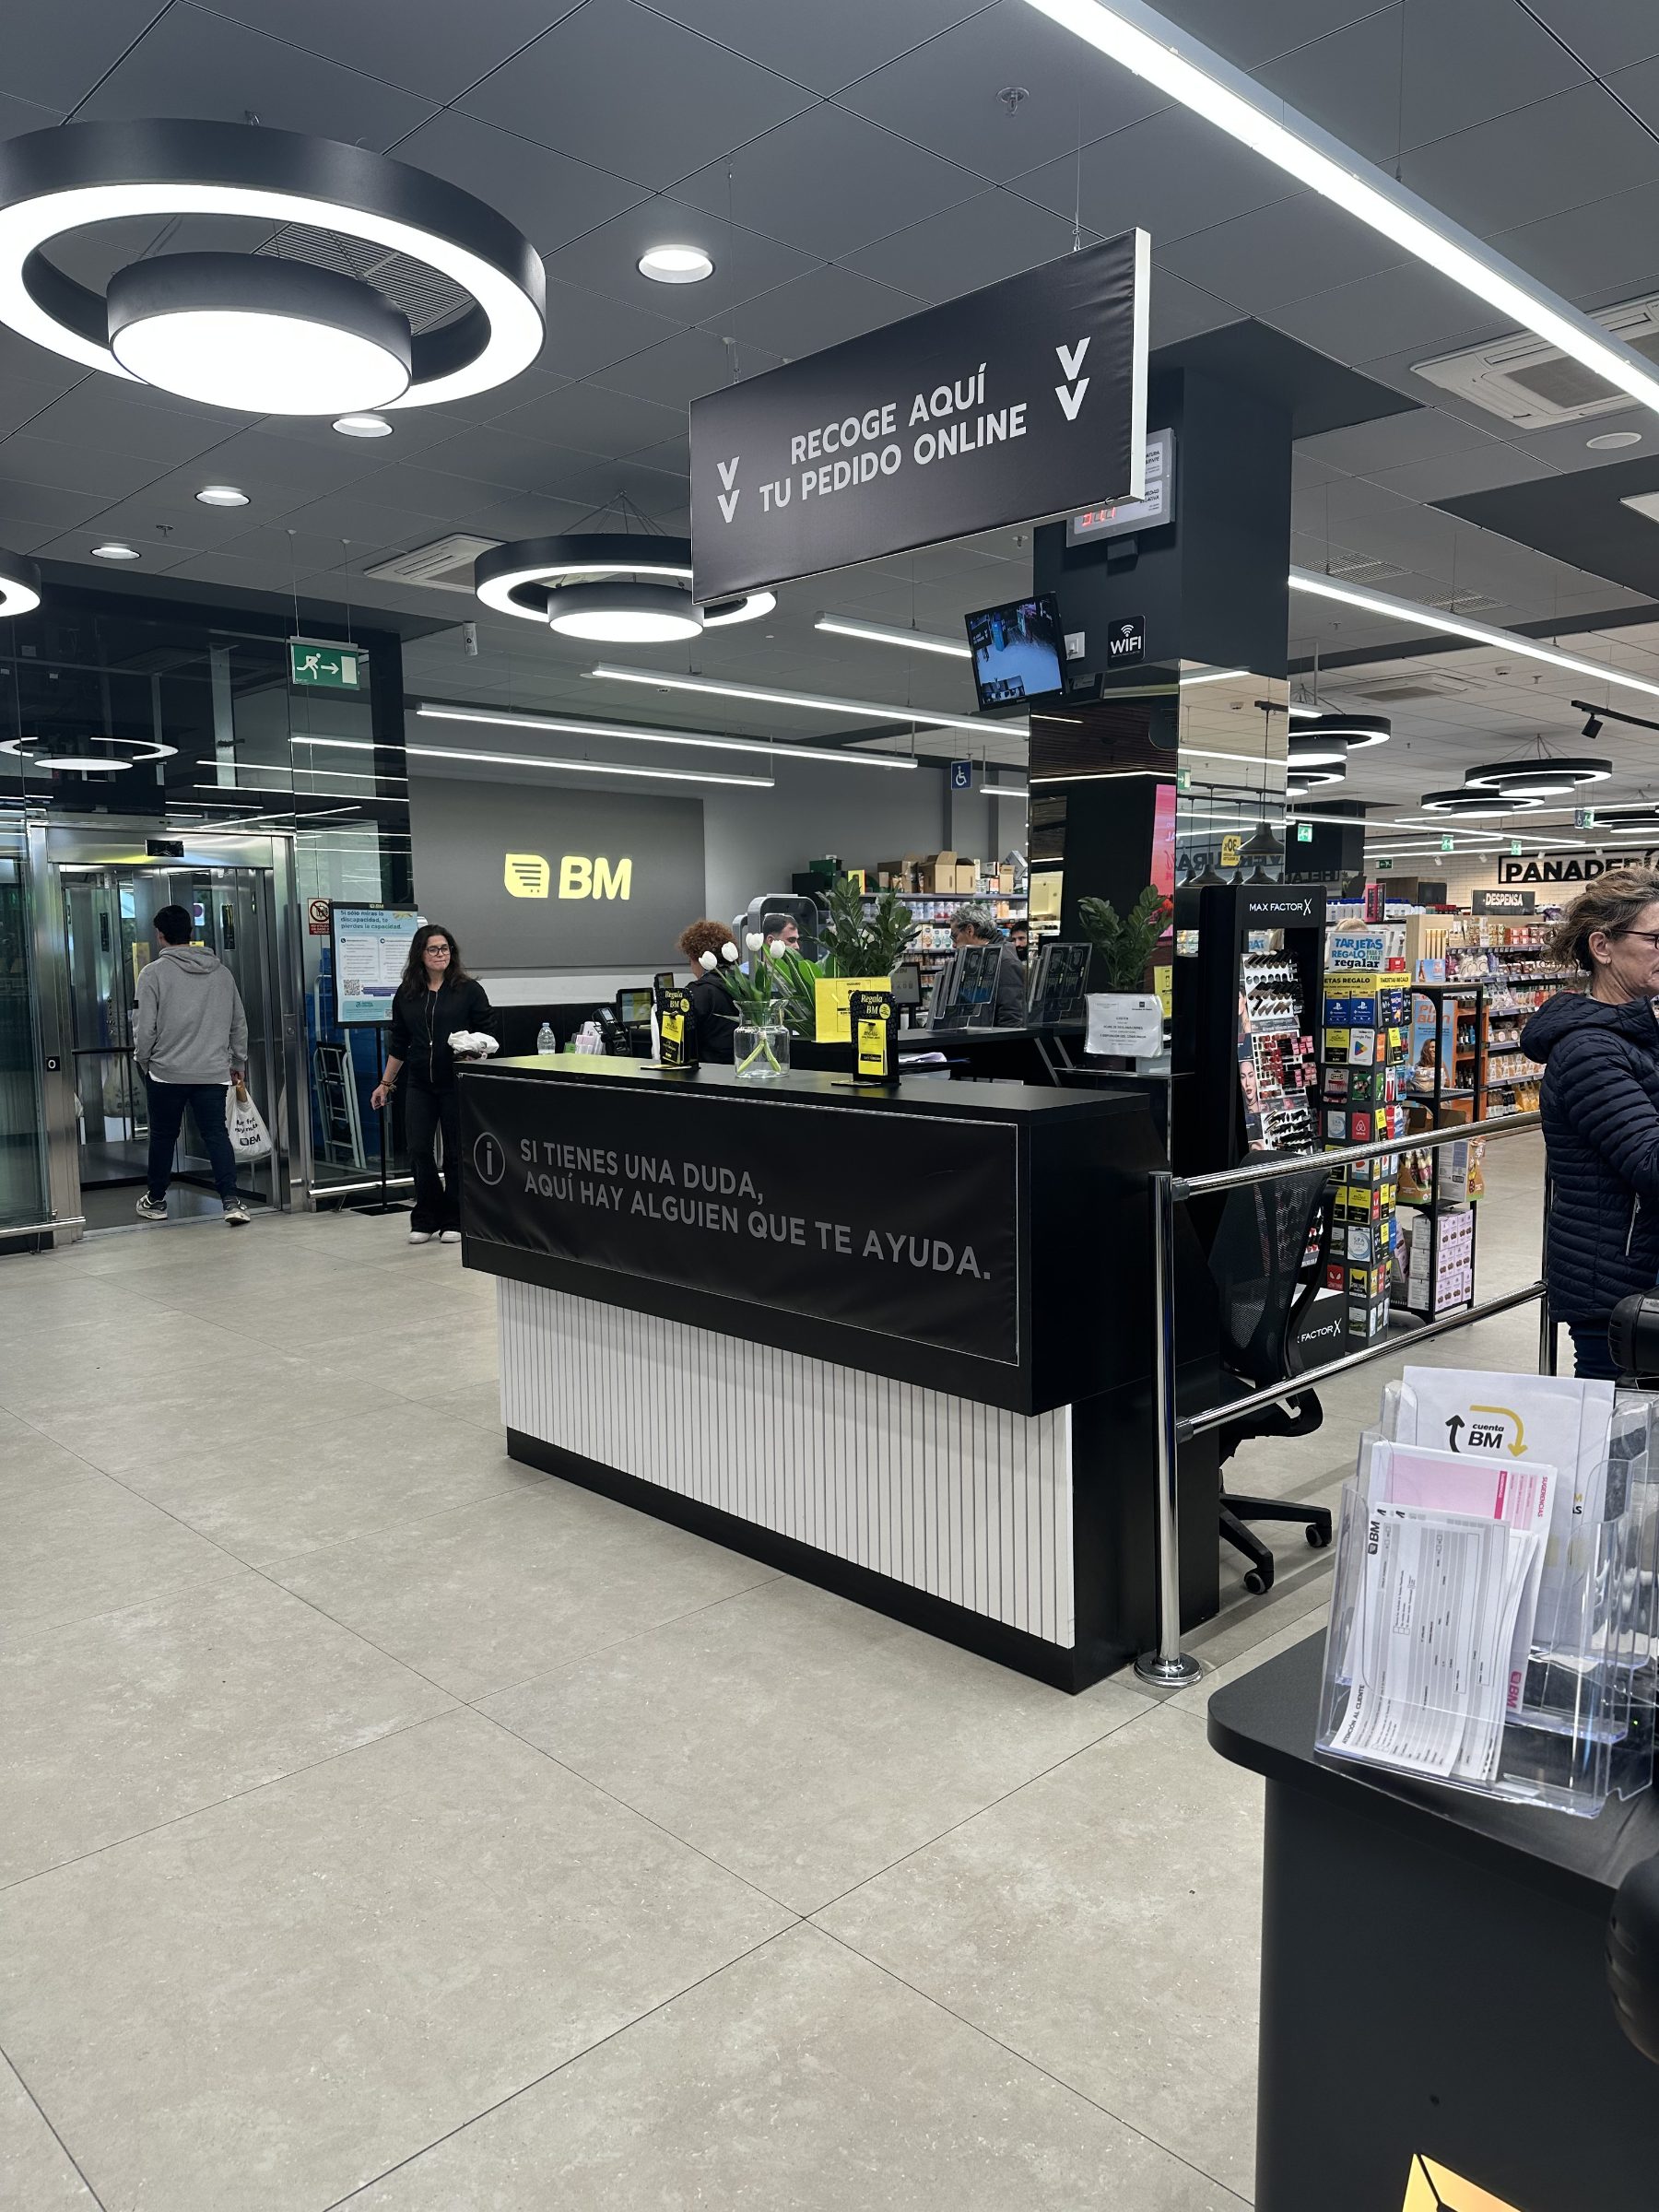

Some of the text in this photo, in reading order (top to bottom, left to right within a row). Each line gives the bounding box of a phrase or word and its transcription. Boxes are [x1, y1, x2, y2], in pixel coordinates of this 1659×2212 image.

[790, 362, 987, 465] RECOGE AQUÍ
[759, 403, 1027, 512] TU PEDIDO ONLINE
[1110, 635, 1142, 655] WIFI
[1506, 849, 1659, 882] PANADEÍ
[558, 855, 632, 900] BM
[1249, 903, 1269, 912] MAX
[1270, 902, 1303, 912] FACTOR
[1485, 893, 1523, 906] DESPENSA
[1332, 950, 1365, 958] REGALO
[1335, 938, 1383, 950] TARJETAS
[1334, 959, 1380, 968] regalar
[861, 994, 883, 1004] Regala
[866, 1005, 879, 1015] BM
[520, 1139, 764, 1206] SI TIENES UNA DUDA,
[524, 1170, 992, 1281] AQUÍ HAY ALGUIEN QUE TE AYUDA.
[1301, 1325, 1333, 1342] FACTOR
[1472, 1423, 1505, 1432] cuenta
[1468, 1431, 1503, 1449] BM
[1538, 1476, 1548, 1518] SUGERENCIAS
[1370, 1521, 1380, 1542] BM
[1507, 1686, 1519, 1708] BM
[1342, 1684, 1365, 1744] ATENCIÓN AL CLIENTE
